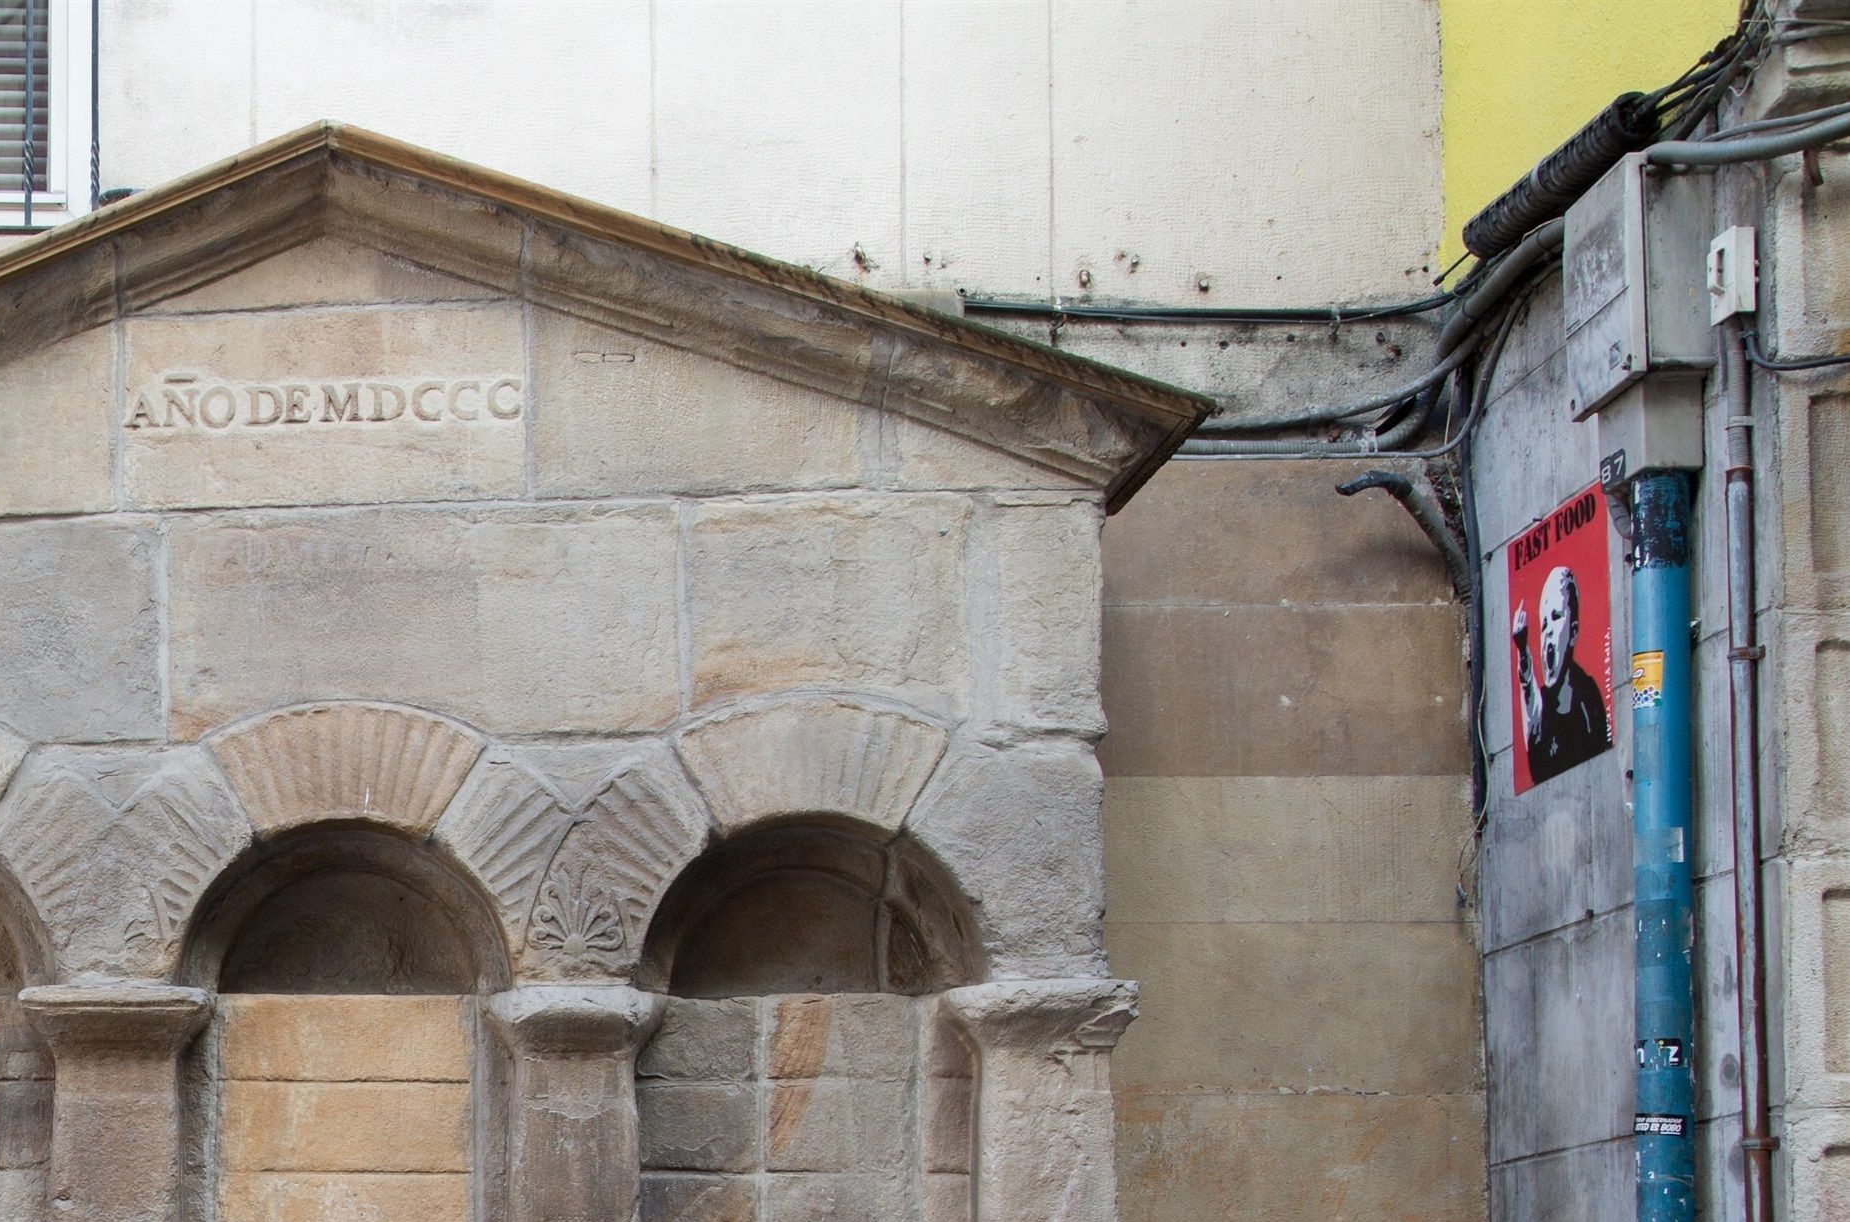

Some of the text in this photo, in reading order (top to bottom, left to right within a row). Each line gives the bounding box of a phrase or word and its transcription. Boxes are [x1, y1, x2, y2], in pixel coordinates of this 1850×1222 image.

[124, 372, 522, 429] AÑO DE MDCCC
[1514, 493, 1596, 571] FAST FOOD
